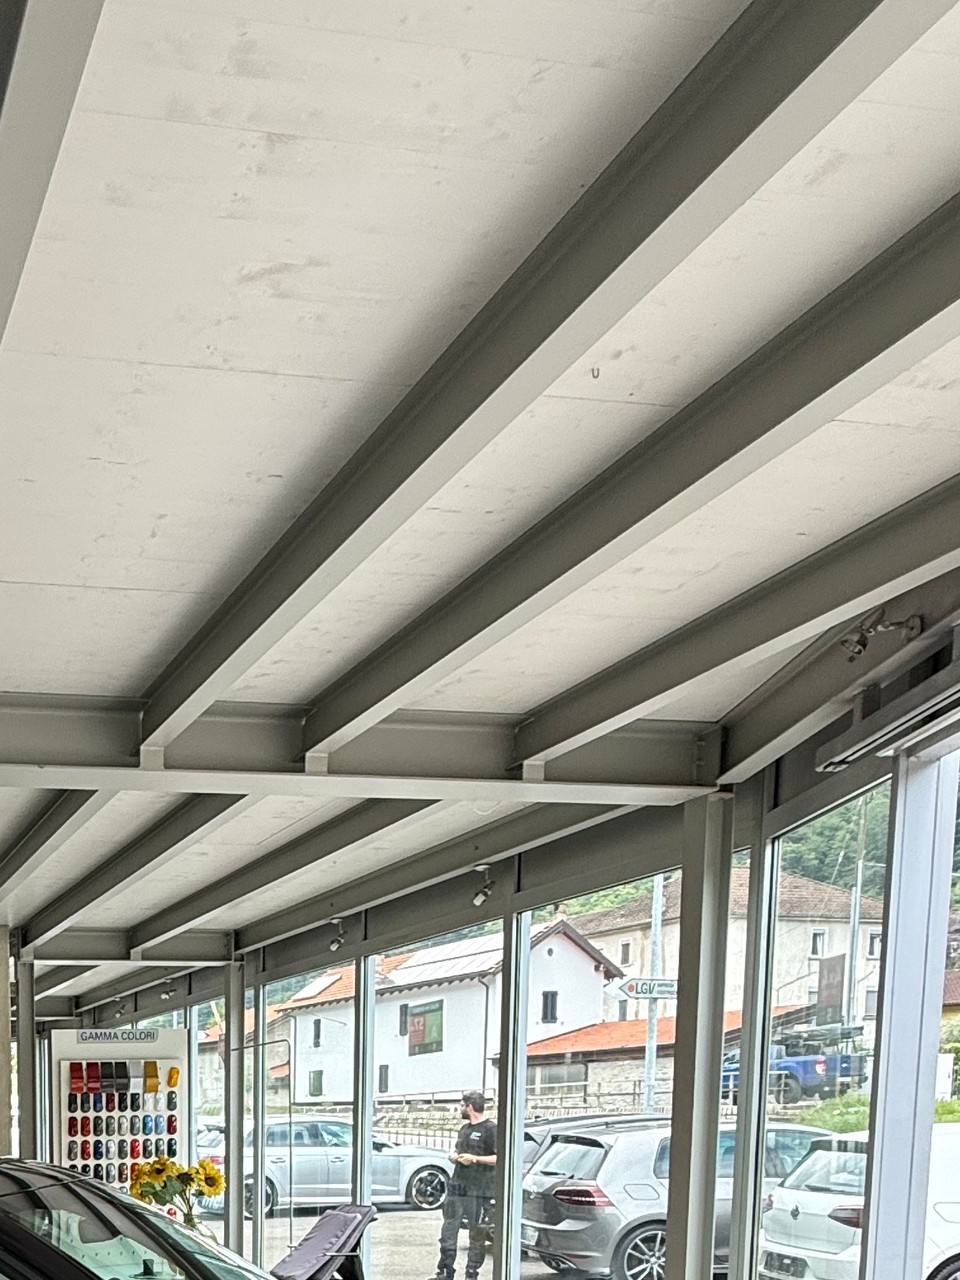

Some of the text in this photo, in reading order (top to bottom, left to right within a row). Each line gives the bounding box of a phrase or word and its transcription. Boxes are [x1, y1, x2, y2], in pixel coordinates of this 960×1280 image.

[635, 982, 656, 994] LGV
[80, 1031, 155, 1041] GAMMA COLORI
